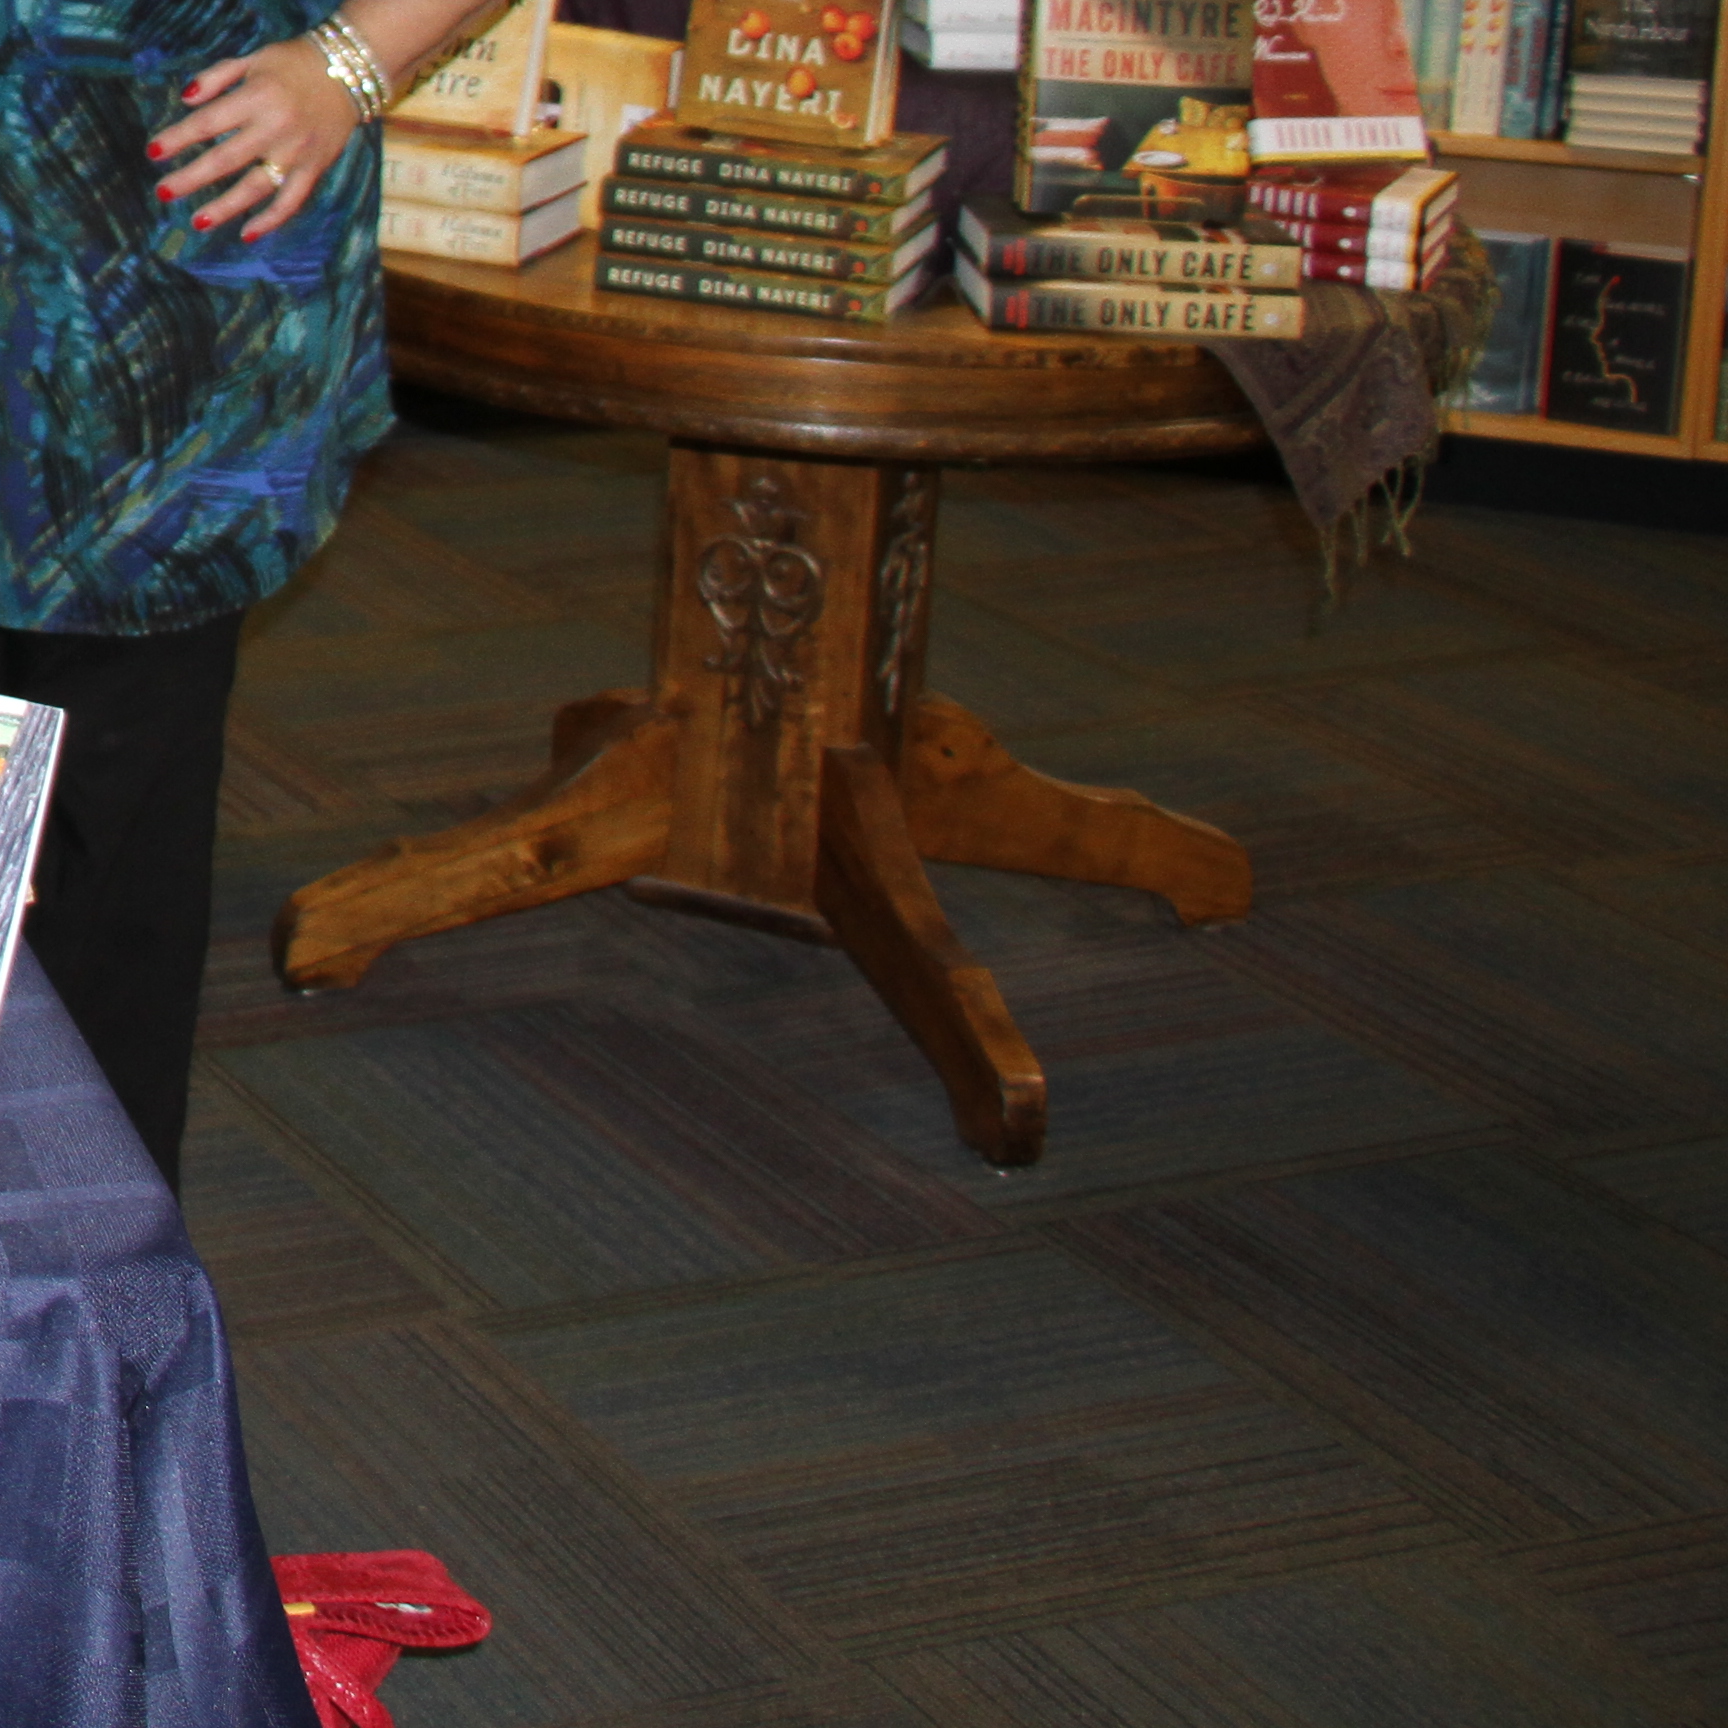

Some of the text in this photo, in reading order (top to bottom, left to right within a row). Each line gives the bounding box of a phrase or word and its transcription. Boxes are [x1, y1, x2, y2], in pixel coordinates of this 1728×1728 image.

[727, 28, 826, 66] DINA
[1045, 47, 1239, 83] THE ONLY CAFÉ
[698, 74, 843, 117] NAYERI
[627, 151, 854, 193] REFUGE DINA NAYERI
[614, 187, 840, 230] REFUGE DINA NAYERI
[611, 228, 836, 272] REFUGE DINA NAYERI
[1028, 242, 1254, 281] THE ONLY CAFÉ
[607, 266, 832, 310] REFUGE DINA NAYERI
[1030, 293, 1257, 332] THE ONLY CAFÉ
